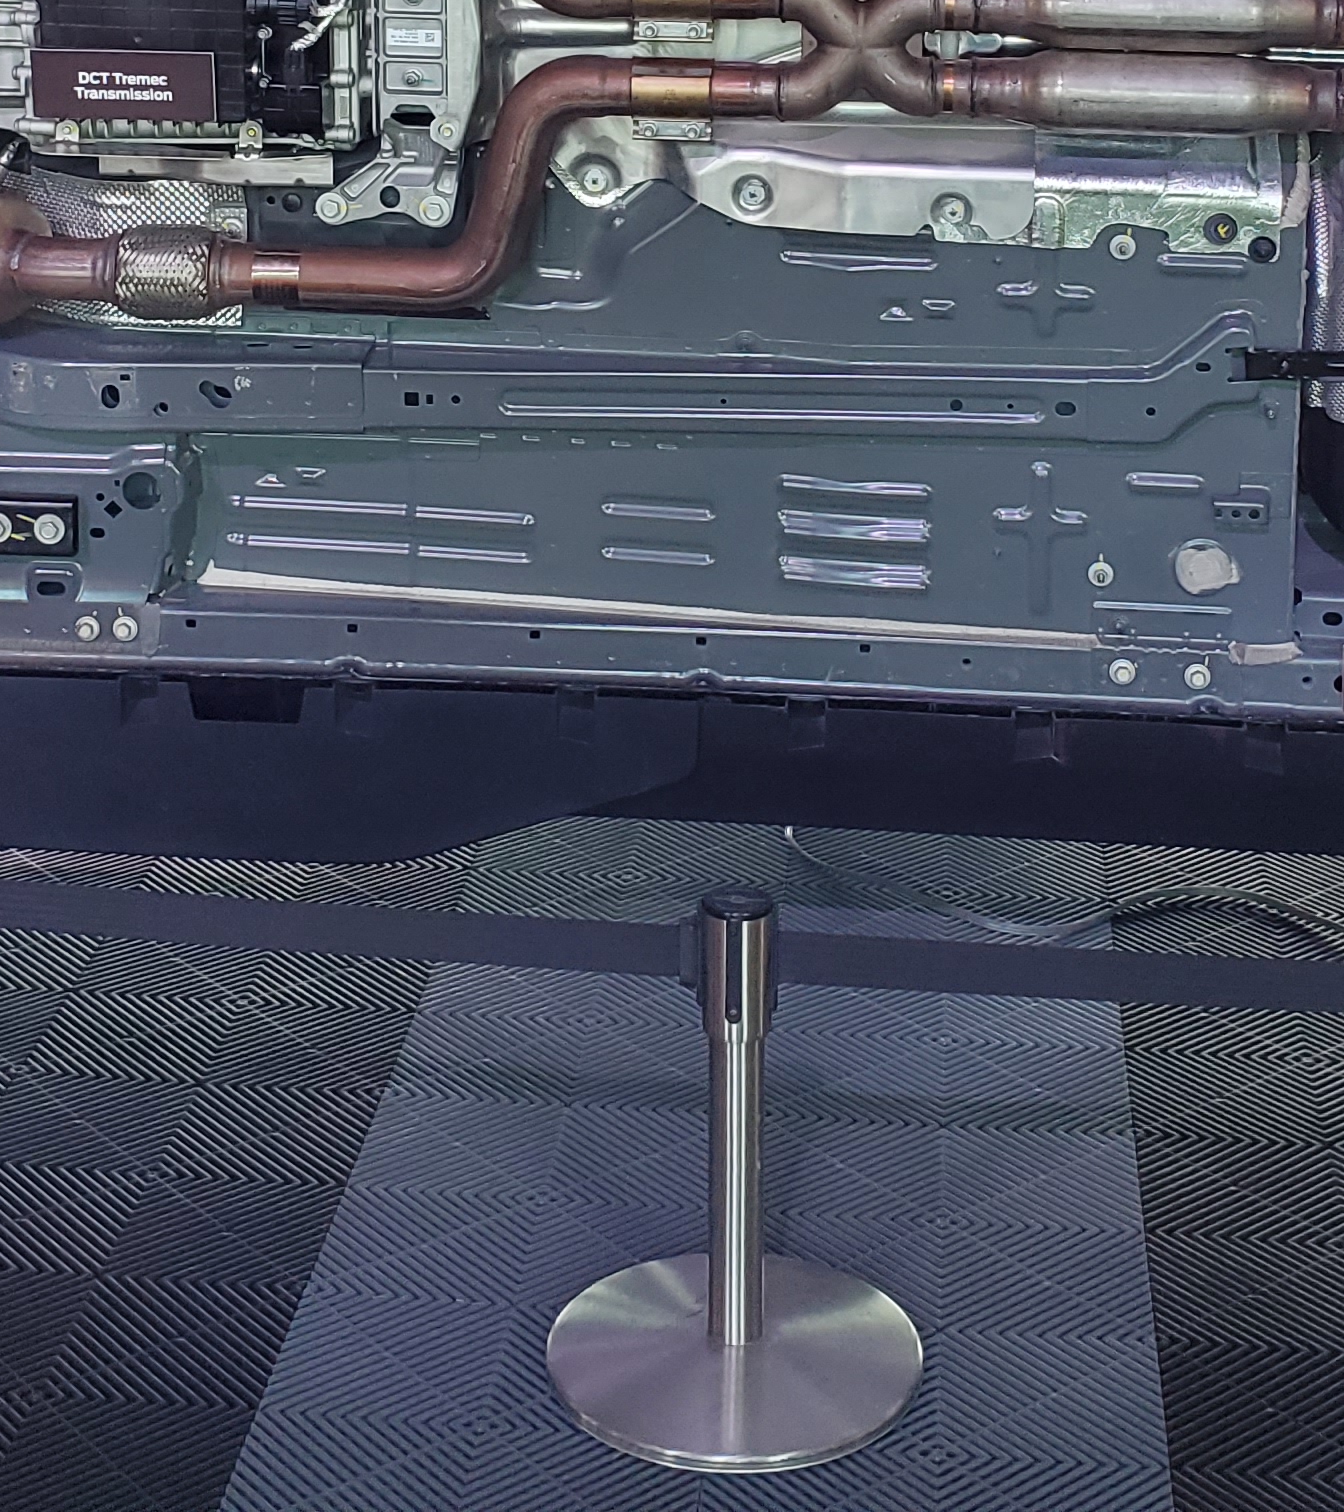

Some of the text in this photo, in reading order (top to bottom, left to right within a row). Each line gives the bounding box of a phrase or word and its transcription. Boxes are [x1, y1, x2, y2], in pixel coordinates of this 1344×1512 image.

[78, 72, 167, 85] DCT Tremec
[74, 87, 172, 101] Transmission
